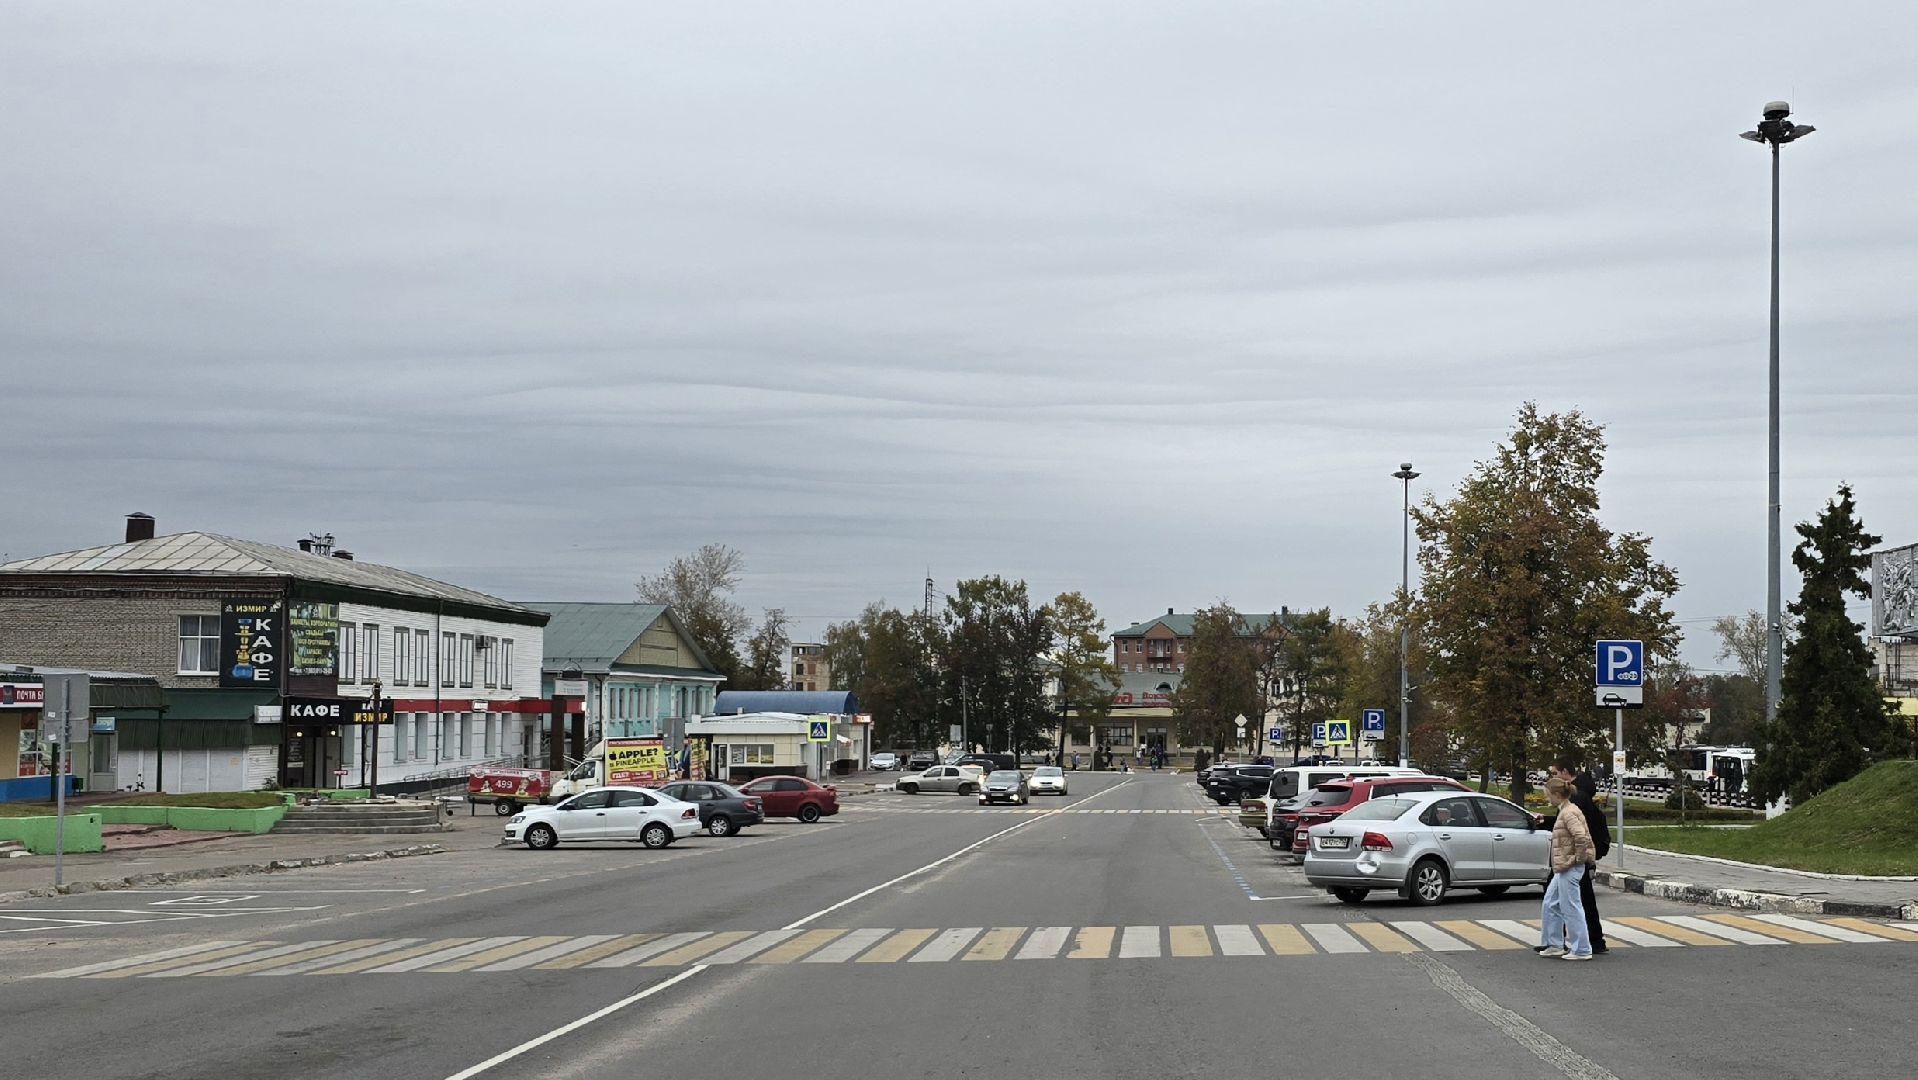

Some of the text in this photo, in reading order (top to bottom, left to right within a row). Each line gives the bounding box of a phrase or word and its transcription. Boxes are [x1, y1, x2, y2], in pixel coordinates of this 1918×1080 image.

[251, 618, 273, 681] КАФЕ
[1607, 645, 1633, 681] P
[290, 704, 340, 717] КАФЕ
[1368, 712, 1380, 728] P
[618, 748, 658, 759] APPLE?
[615, 757, 656, 767] PINEAPPLE
[495, 780, 513, 789] 499
